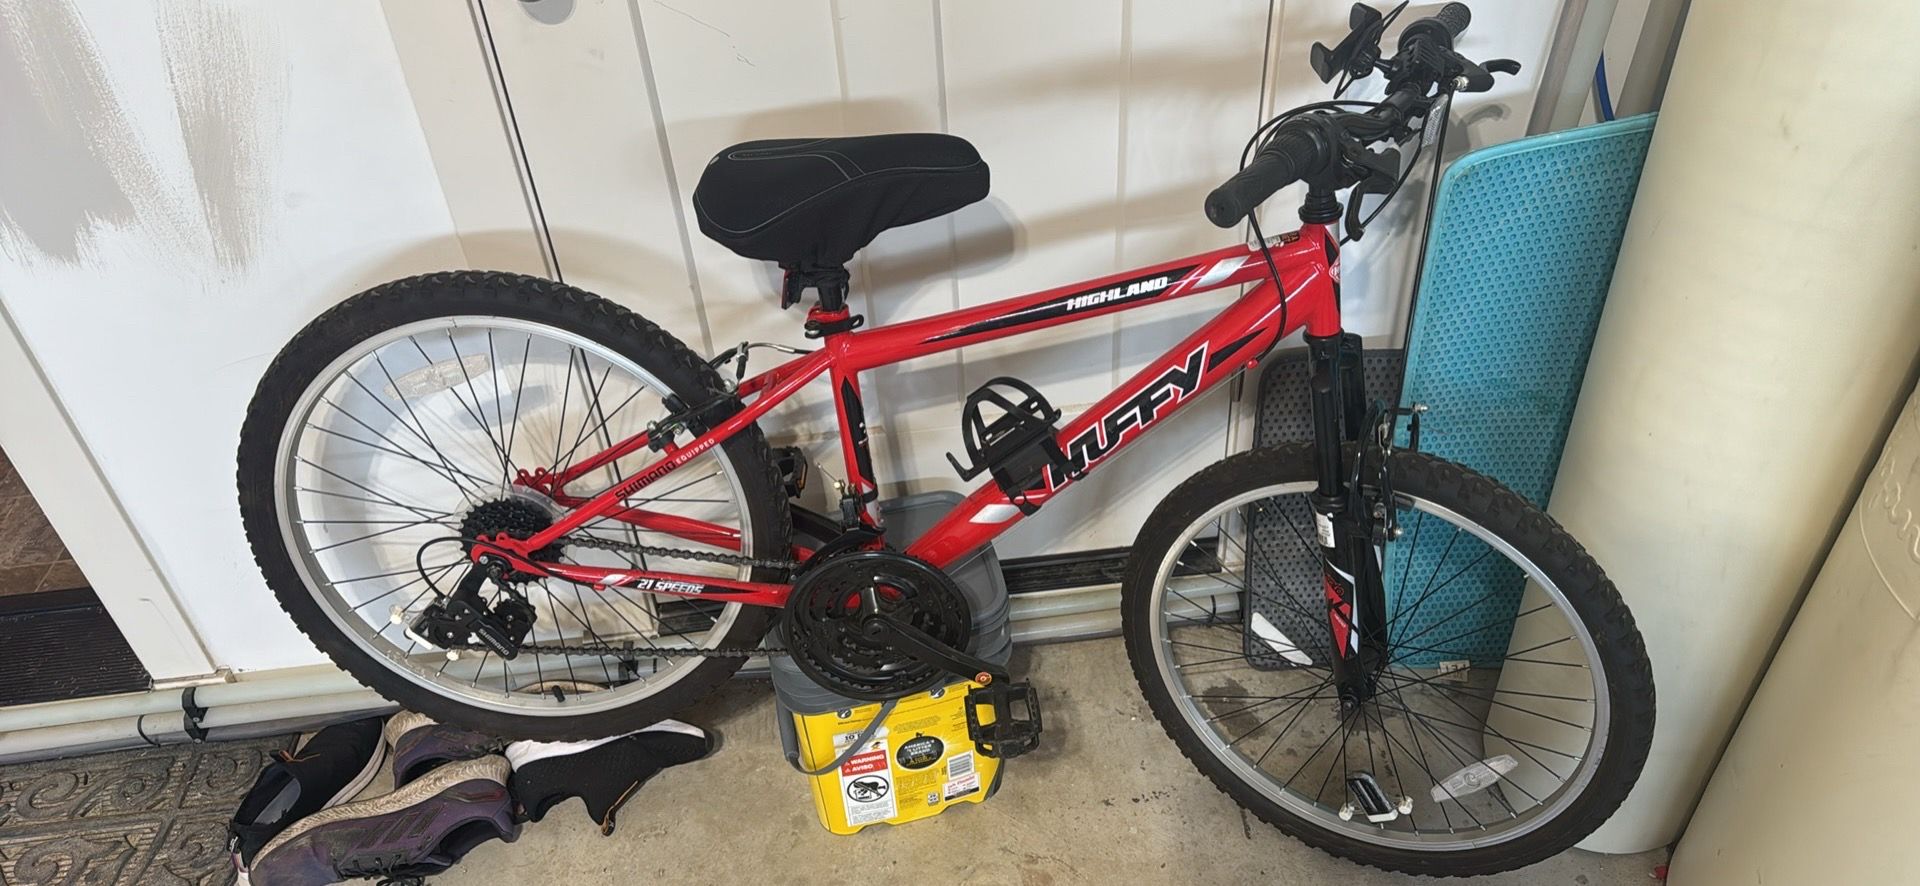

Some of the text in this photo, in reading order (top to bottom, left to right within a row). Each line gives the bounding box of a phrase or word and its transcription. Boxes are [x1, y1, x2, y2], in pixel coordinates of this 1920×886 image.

[1066, 275, 1169, 312] HIGHLAND
[614, 437, 715, 500] SHIMANO EQUIPPED
[637, 578, 705, 595] 21 SPEEDS
[478, 628, 510, 656] SHIMANO
[850, 754, 885, 765] WARNING
[851, 763, 874, 772] AVISO
